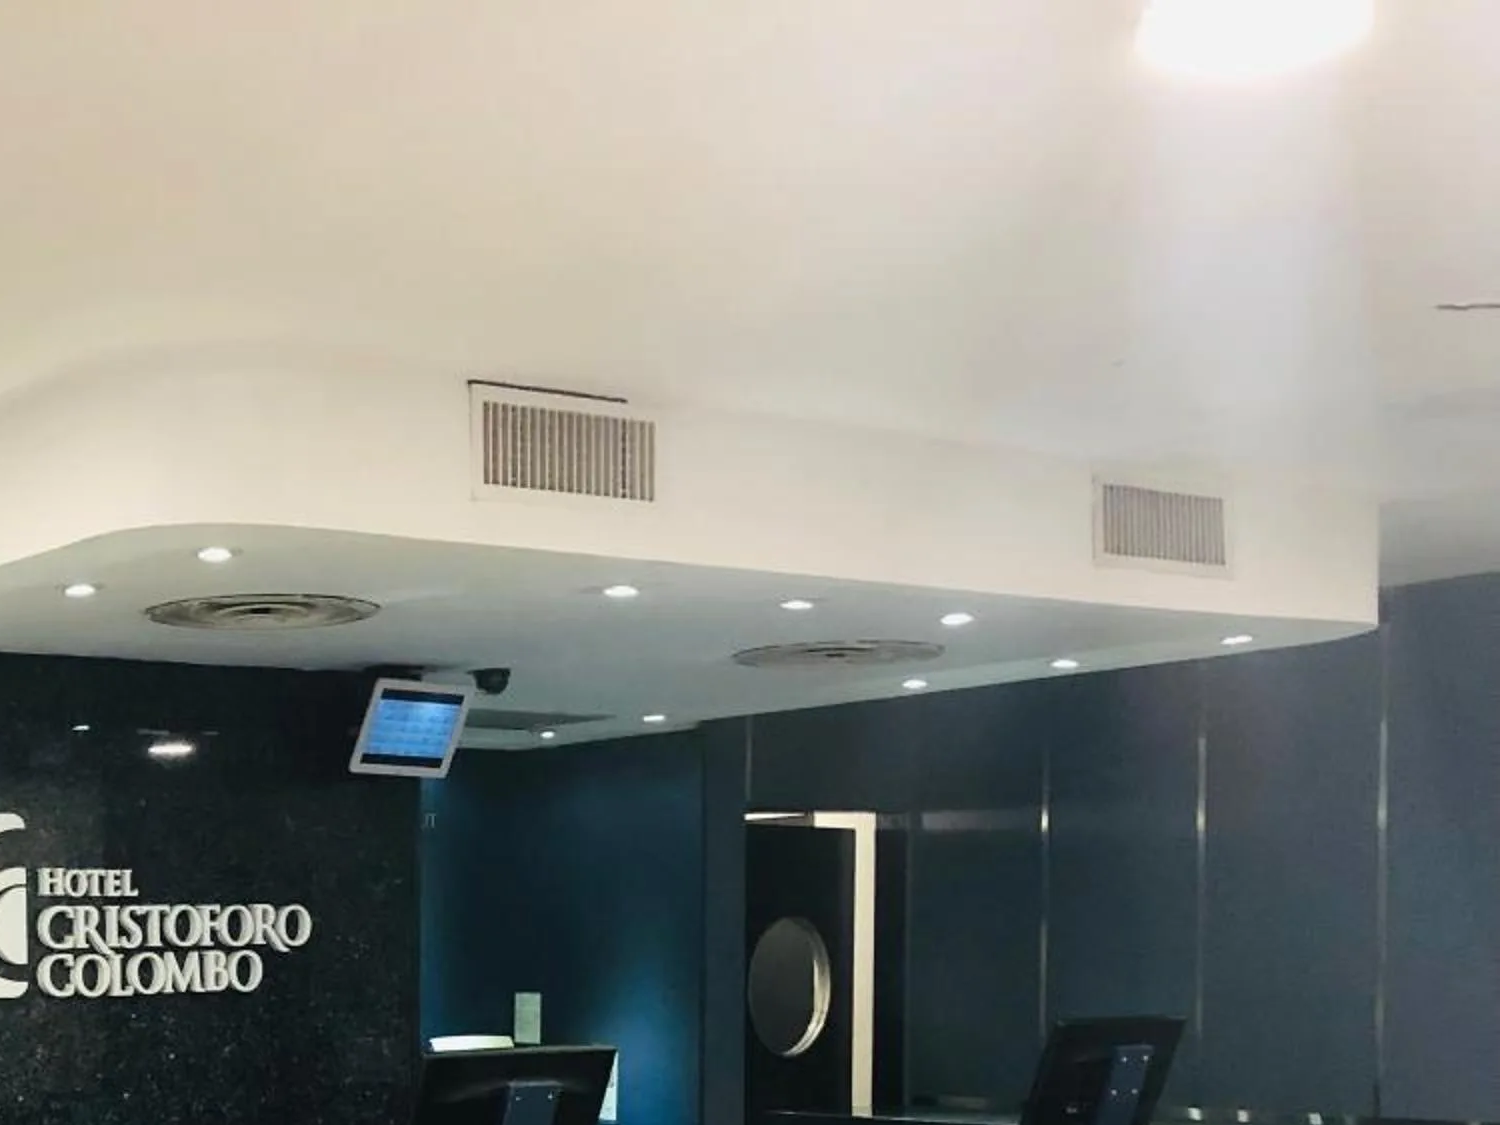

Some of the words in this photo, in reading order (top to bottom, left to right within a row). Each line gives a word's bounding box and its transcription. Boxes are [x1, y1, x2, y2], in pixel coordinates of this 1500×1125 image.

[37, 867, 138, 897] HOTEL
[37, 904, 312, 952] CRISTOFORO
[36, 949, 263, 998] COLOMBO
